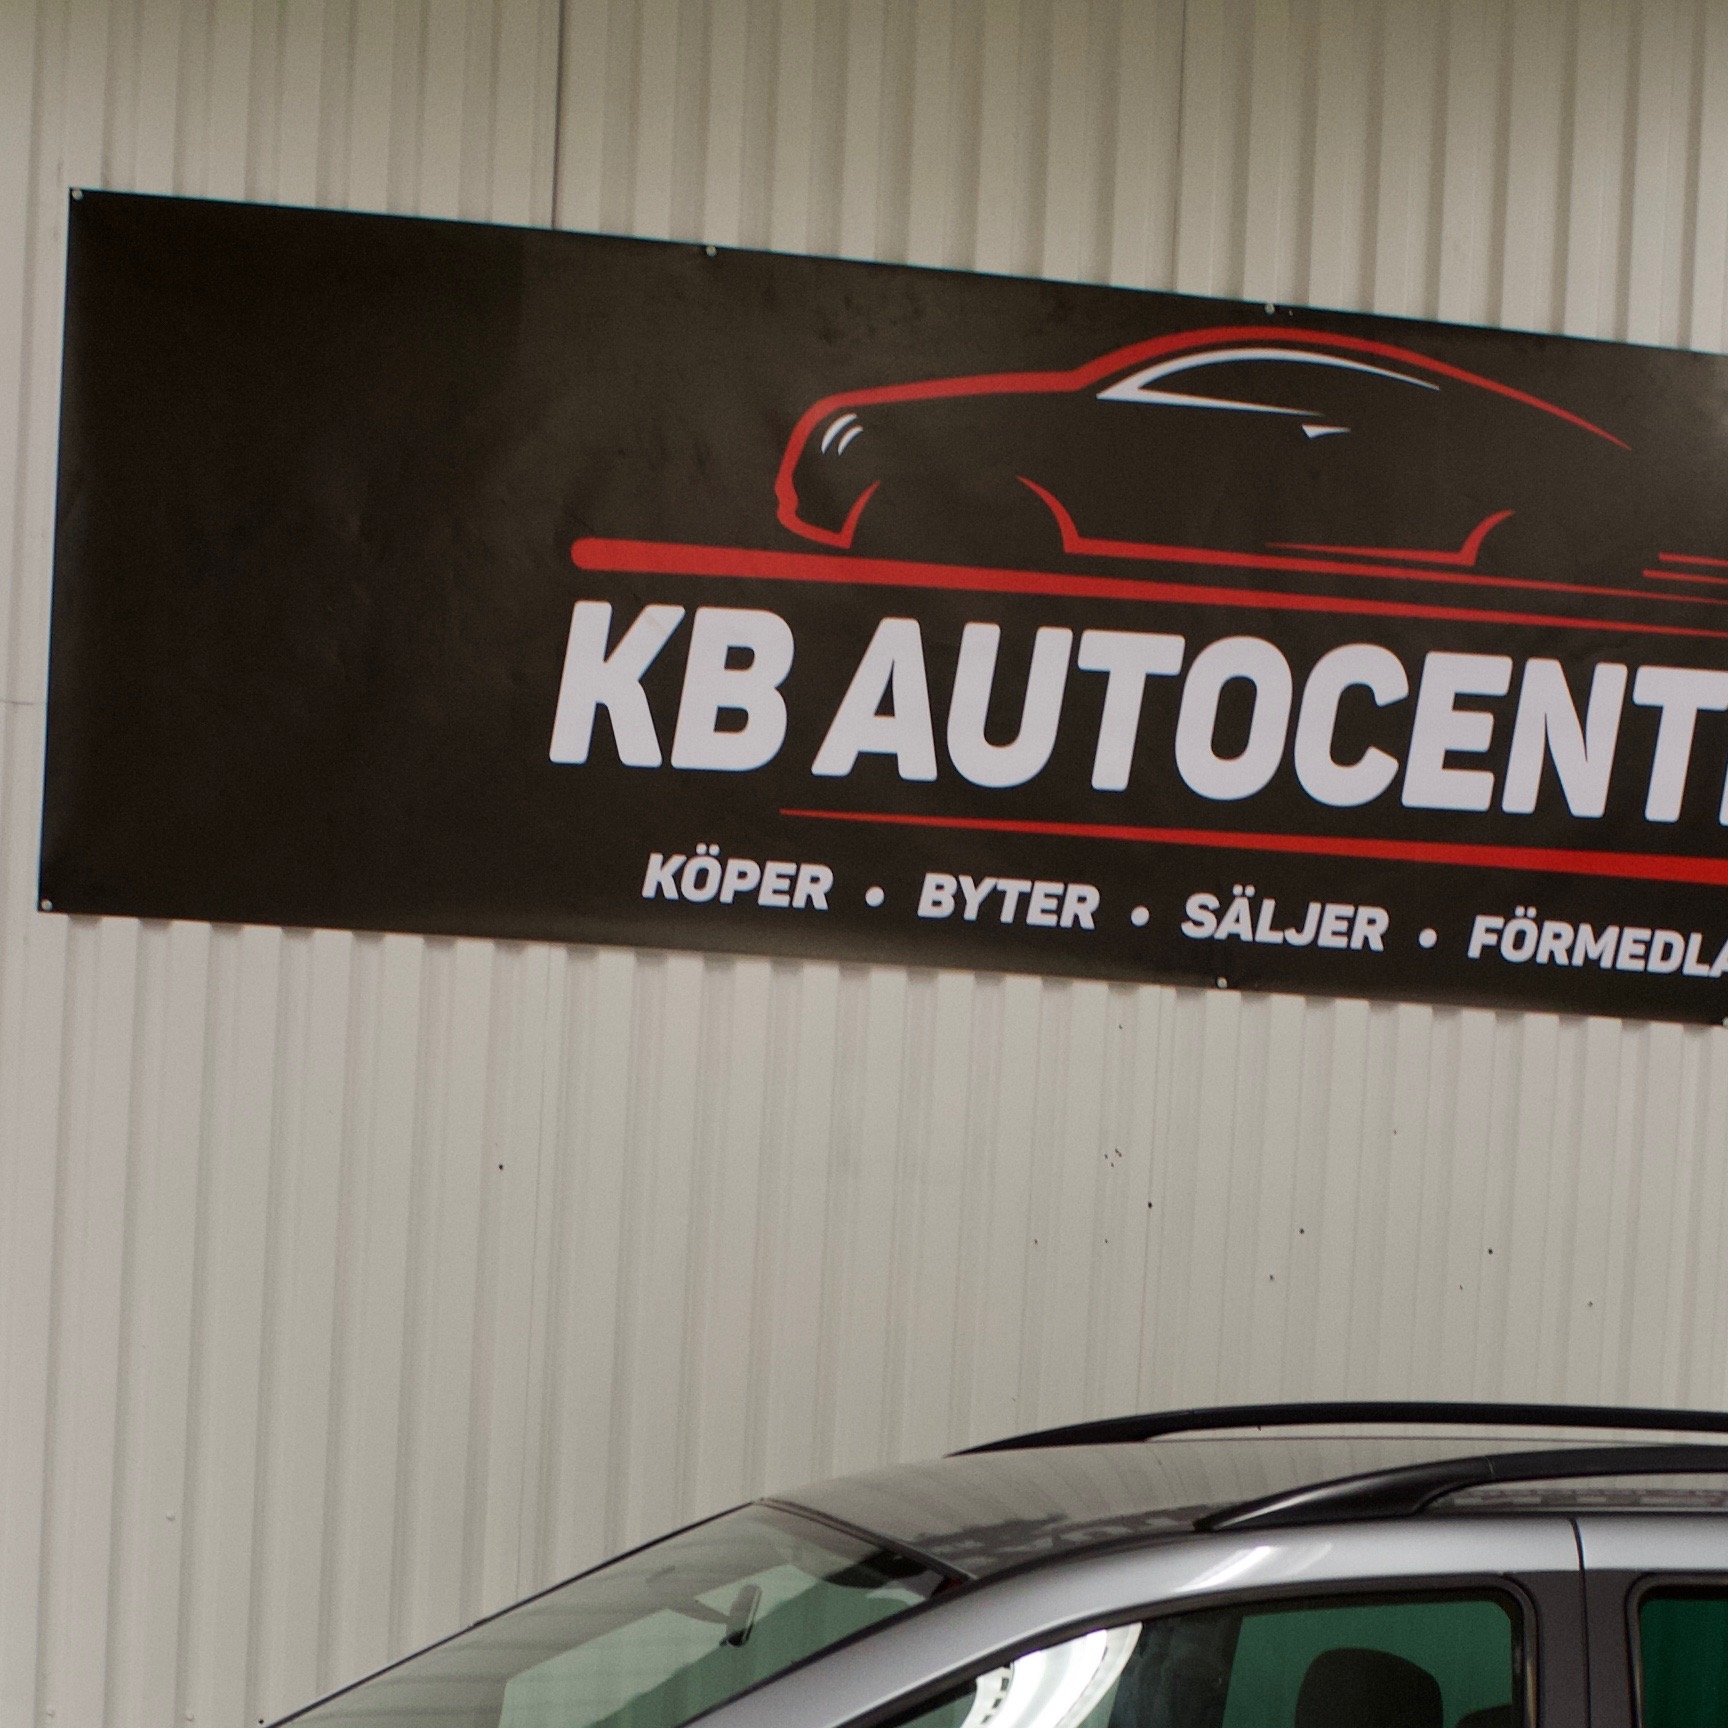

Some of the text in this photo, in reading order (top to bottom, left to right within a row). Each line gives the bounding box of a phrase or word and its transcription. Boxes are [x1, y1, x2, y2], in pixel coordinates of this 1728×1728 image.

[549, 600, 795, 771] KB
[641, 843, 834, 910] KÖPER
[917, 872, 1101, 930] BYTER
[1180, 884, 1390, 952] SÄLJER
